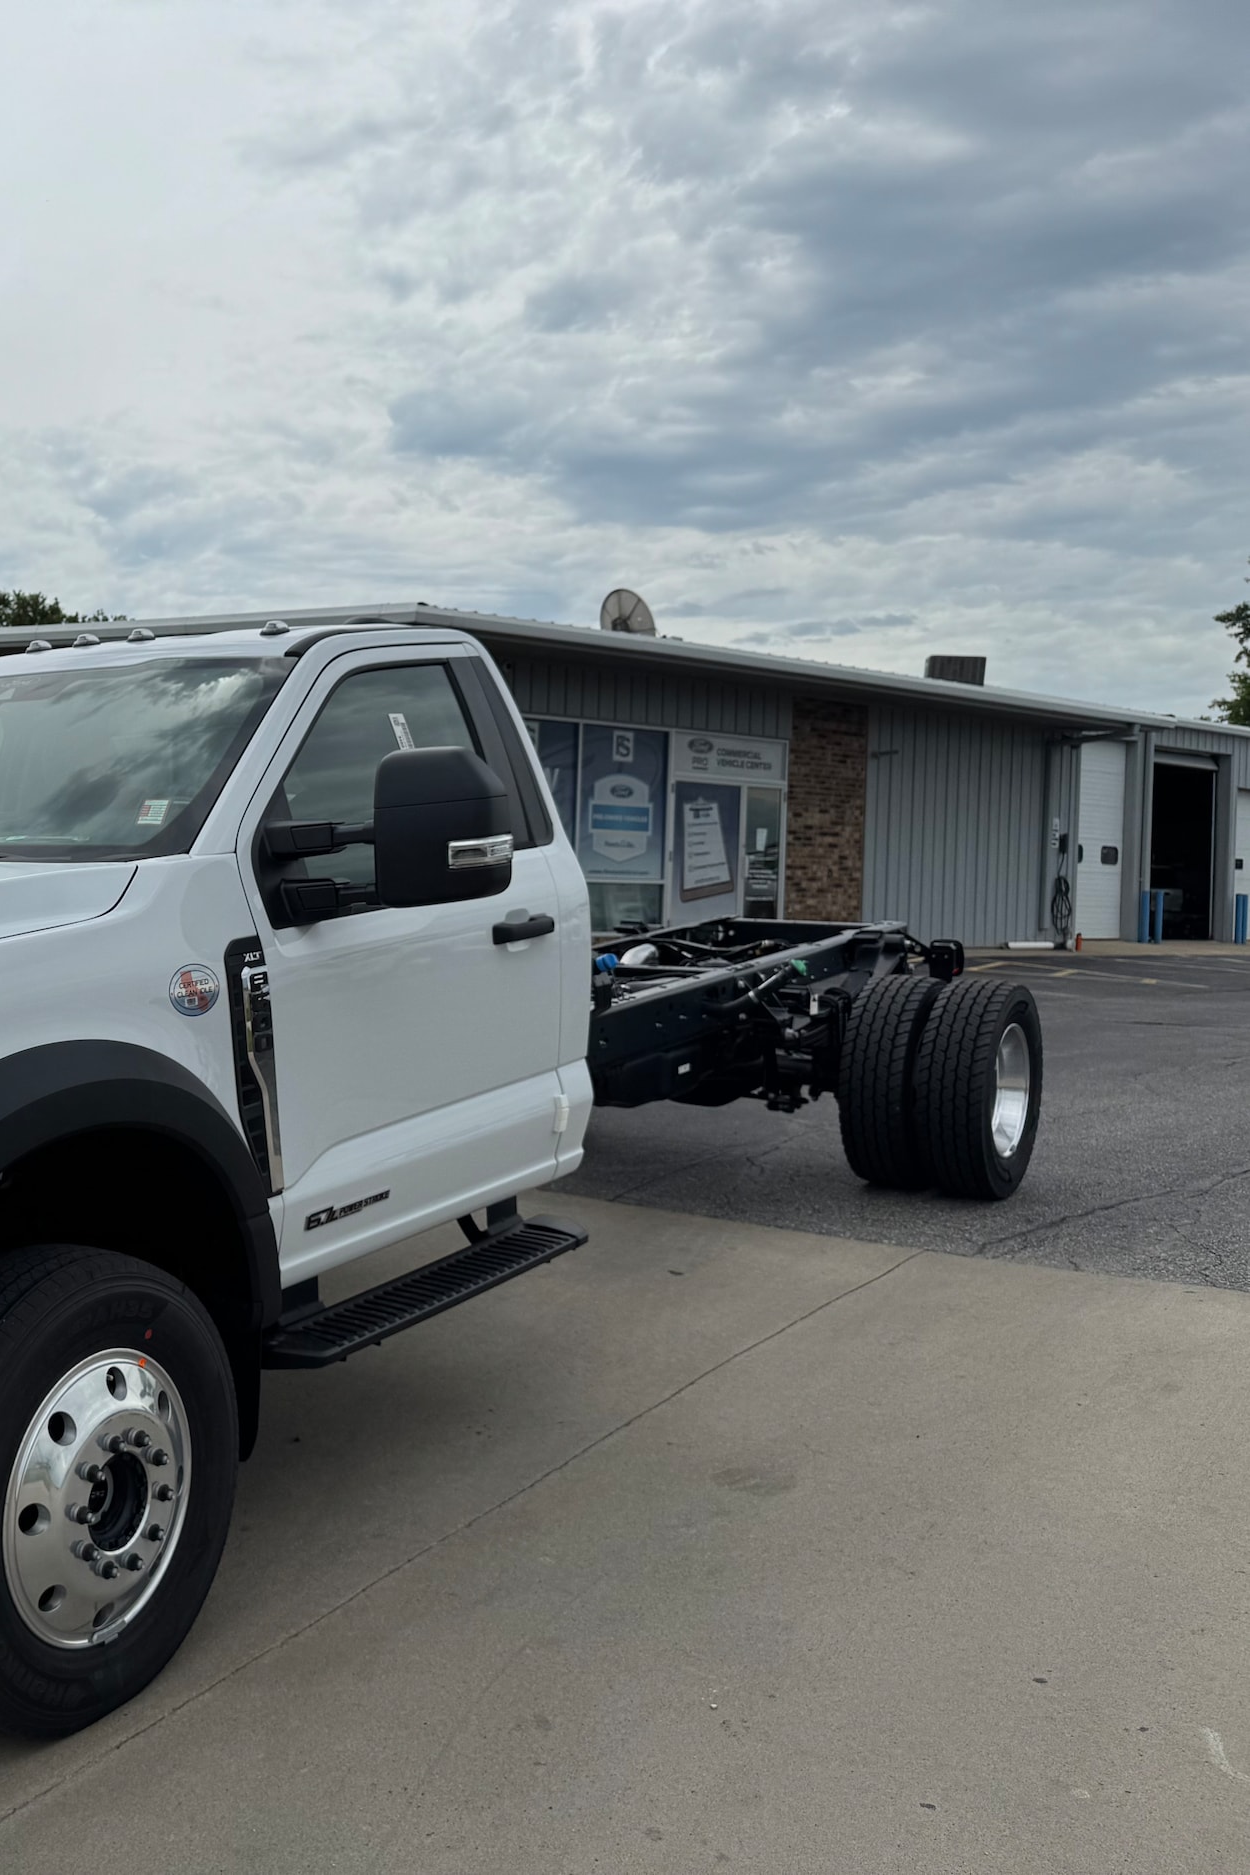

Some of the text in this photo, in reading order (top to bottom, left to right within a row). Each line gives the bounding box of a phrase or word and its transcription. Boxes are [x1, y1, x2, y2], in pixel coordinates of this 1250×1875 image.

[716, 747, 762, 760] COMMERCIAL
[692, 756, 708, 767] PRO
[716, 758, 772, 771] VEHICLE CENTER
[243, 951, 261, 962] XLT
[179, 978, 209, 989] CERTIFIED
[177, 990, 198, 998] CLEAN
